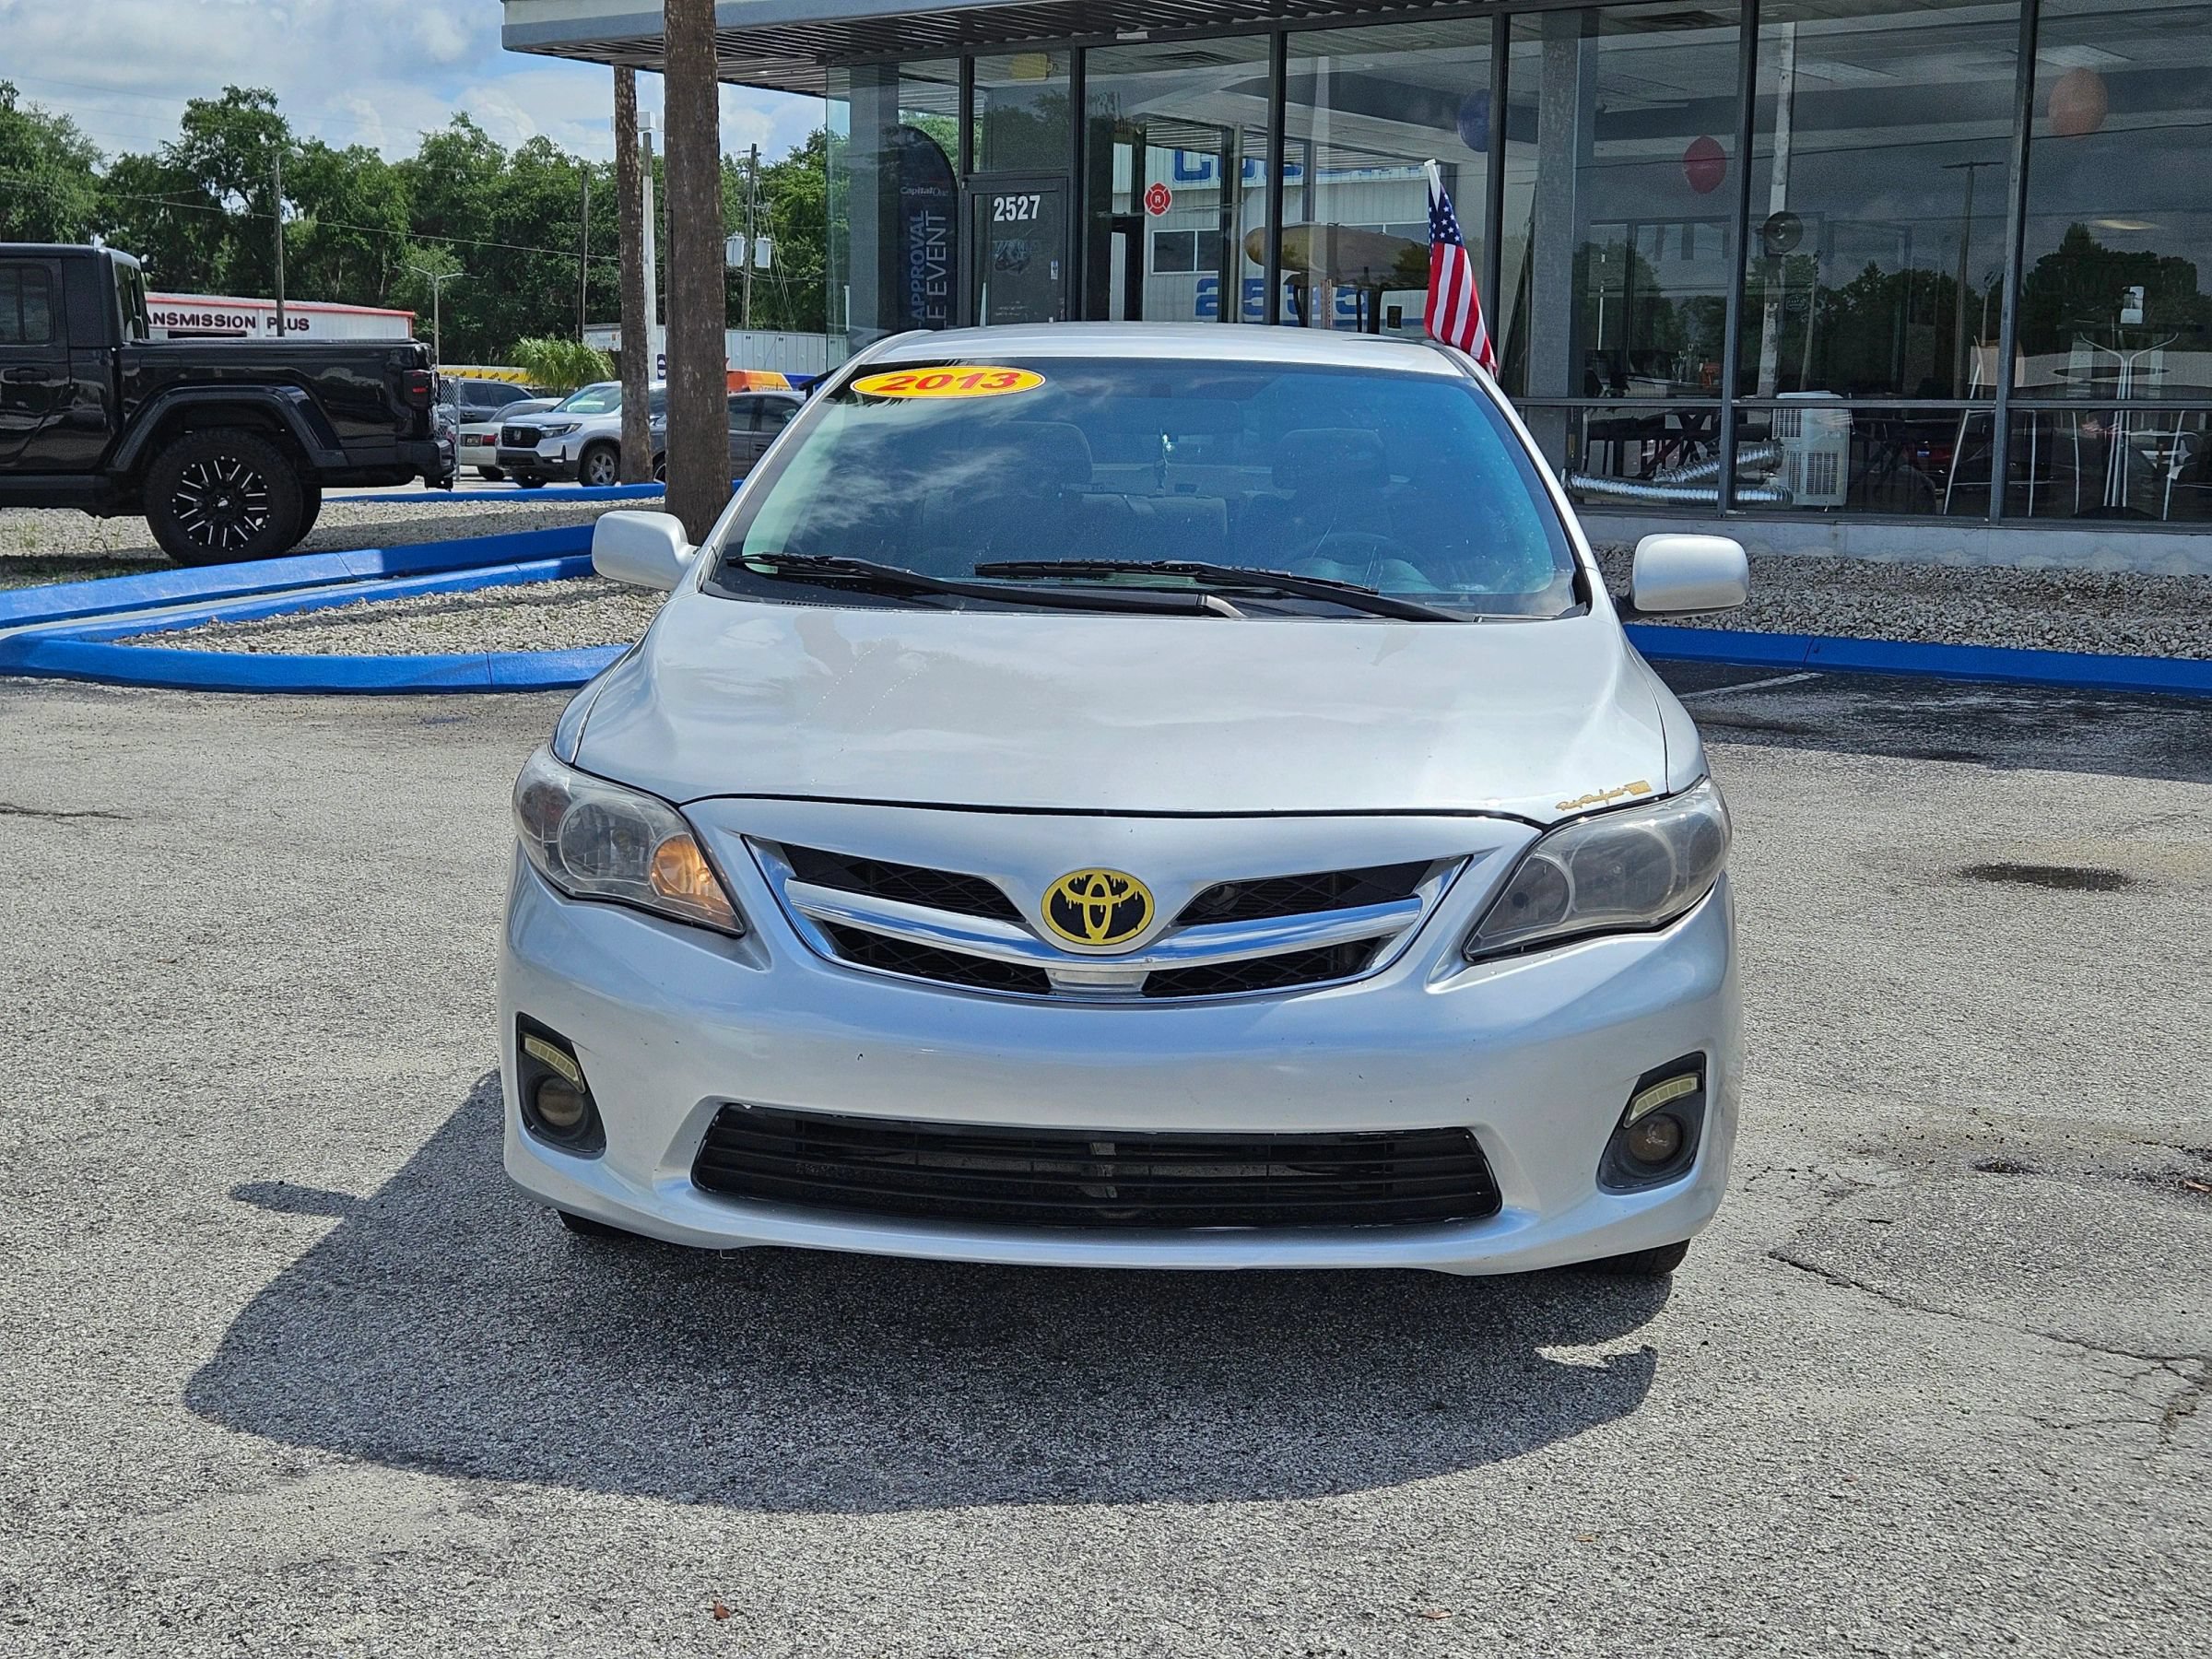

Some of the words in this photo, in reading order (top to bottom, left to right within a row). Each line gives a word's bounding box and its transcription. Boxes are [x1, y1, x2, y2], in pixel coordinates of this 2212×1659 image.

[994, 194, 1041, 222] 2527
[925, 210, 947, 296] EVENT
[873, 371, 1021, 393] 2013
